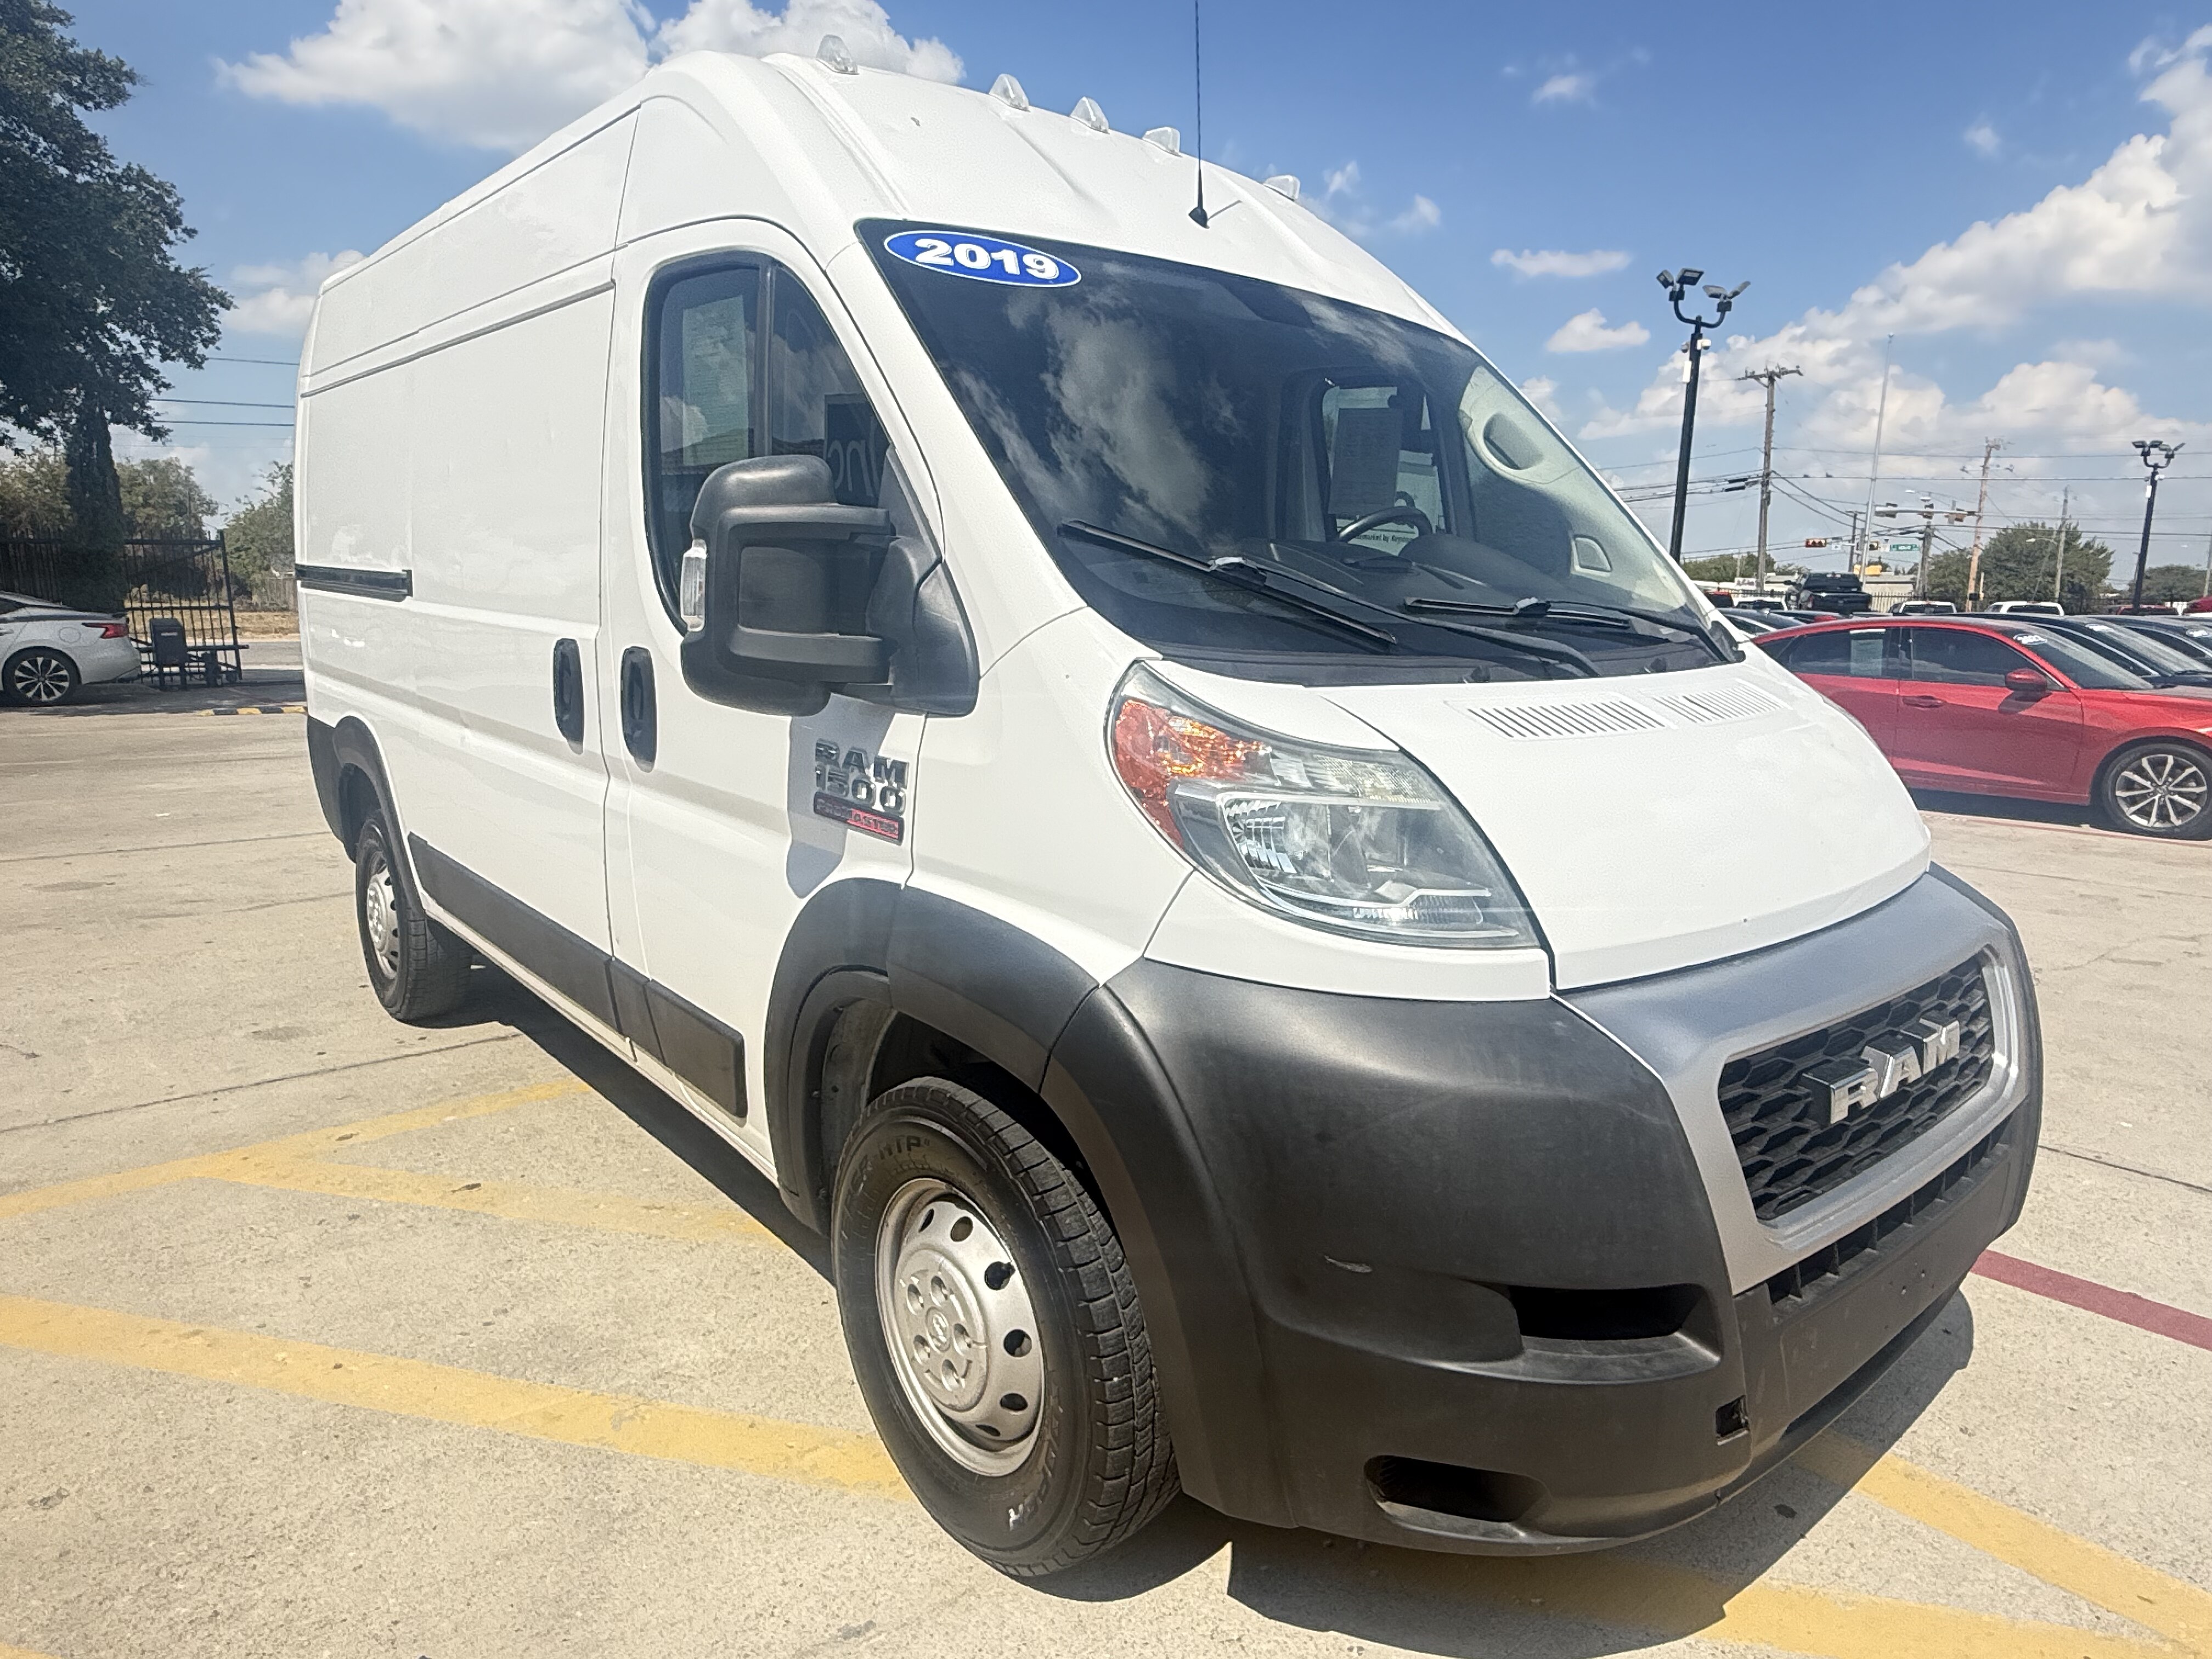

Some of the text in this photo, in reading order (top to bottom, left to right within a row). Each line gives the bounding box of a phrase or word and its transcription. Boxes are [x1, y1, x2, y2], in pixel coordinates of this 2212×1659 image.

[915, 238, 1059, 280] 2019
[815, 738, 909, 790] RAM
[815, 764, 906, 815] 1500
[1824, 1019, 1960, 1125] RAM
